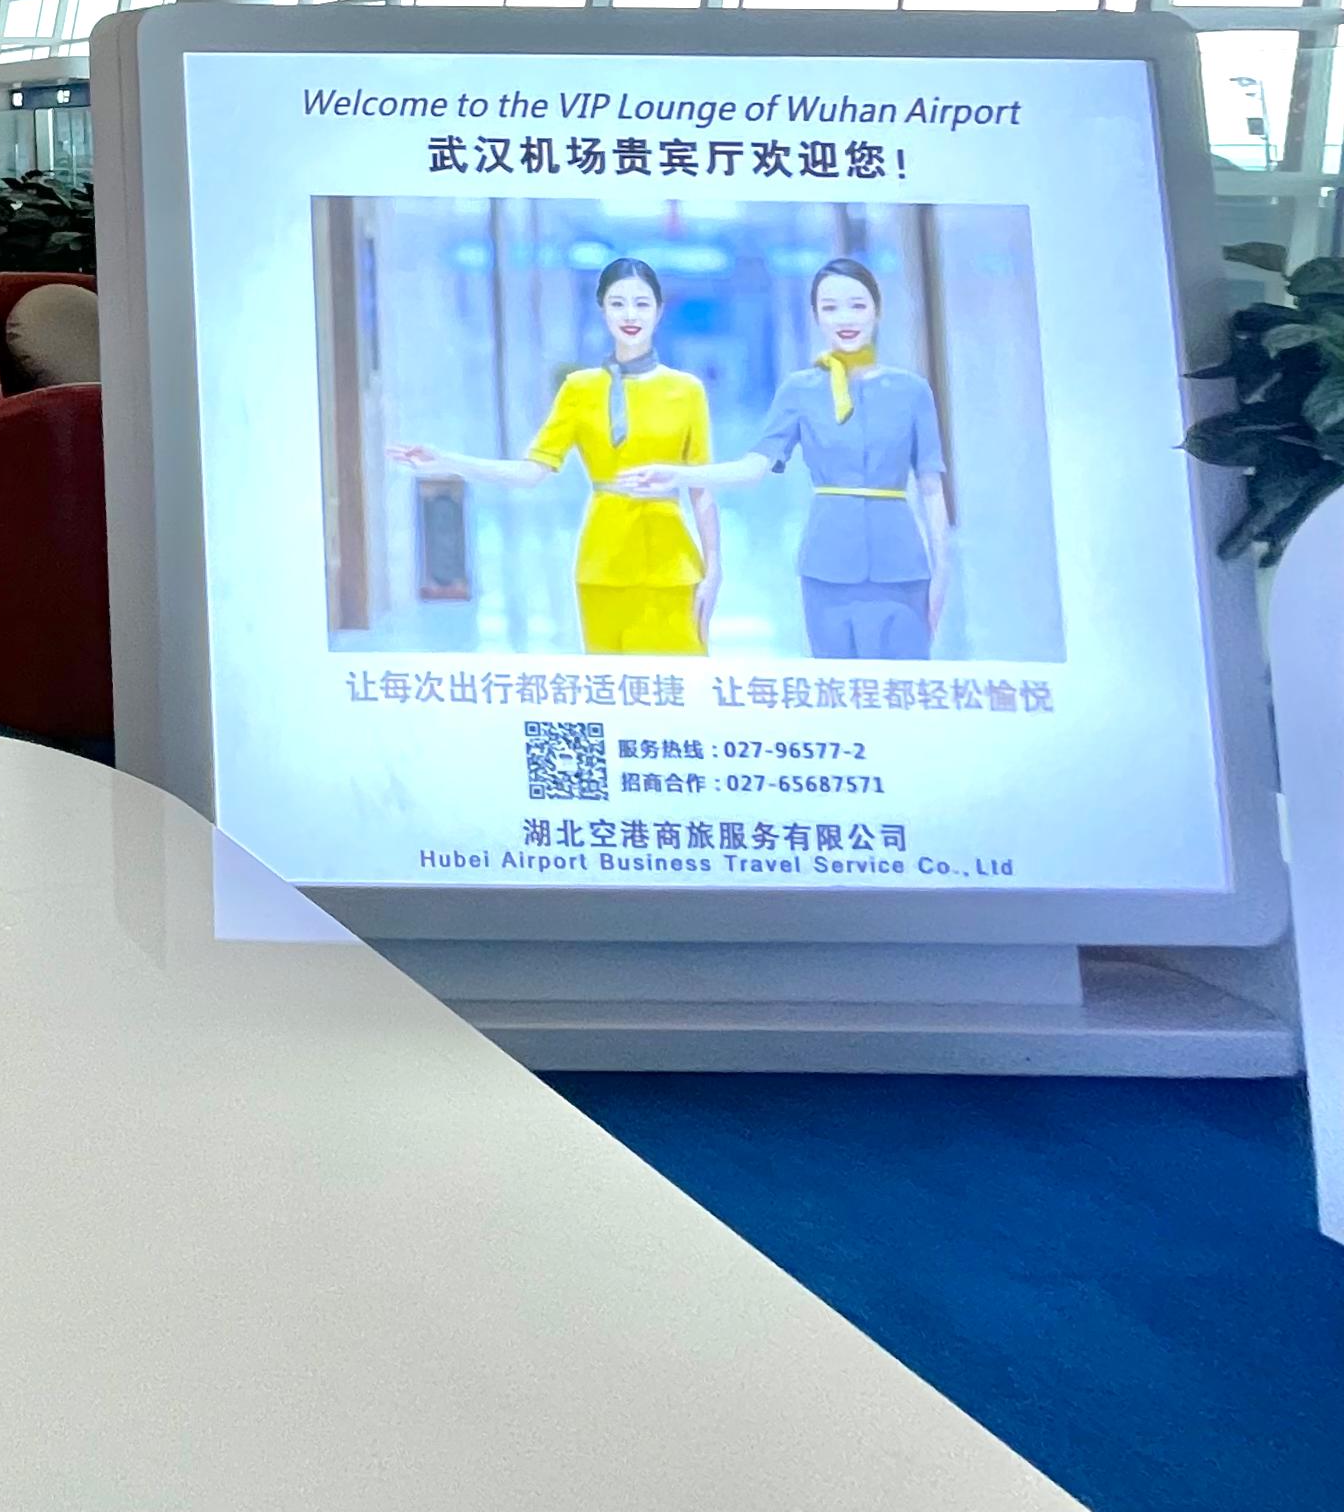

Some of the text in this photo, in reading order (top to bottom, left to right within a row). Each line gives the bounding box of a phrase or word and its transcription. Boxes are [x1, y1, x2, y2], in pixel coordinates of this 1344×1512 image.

[302, 88, 1024, 132] Welcome to the VIP Lounge of Wuhan Airport
[426, 134, 906, 180] 武汉机场贵宾厅欢迎您！
[345, 669, 1056, 714] 让每次出行都舒适便捷 让每段旅程都轻松愉悦
[522, 818, 908, 853] 湖北空港商旅服务有限公司
[419, 849, 490, 868] Hubei
[501, 851, 589, 872] Airport
[599, 853, 713, 872] Business
[723, 854, 801, 873] Travel
[813, 855, 906, 875] Service
